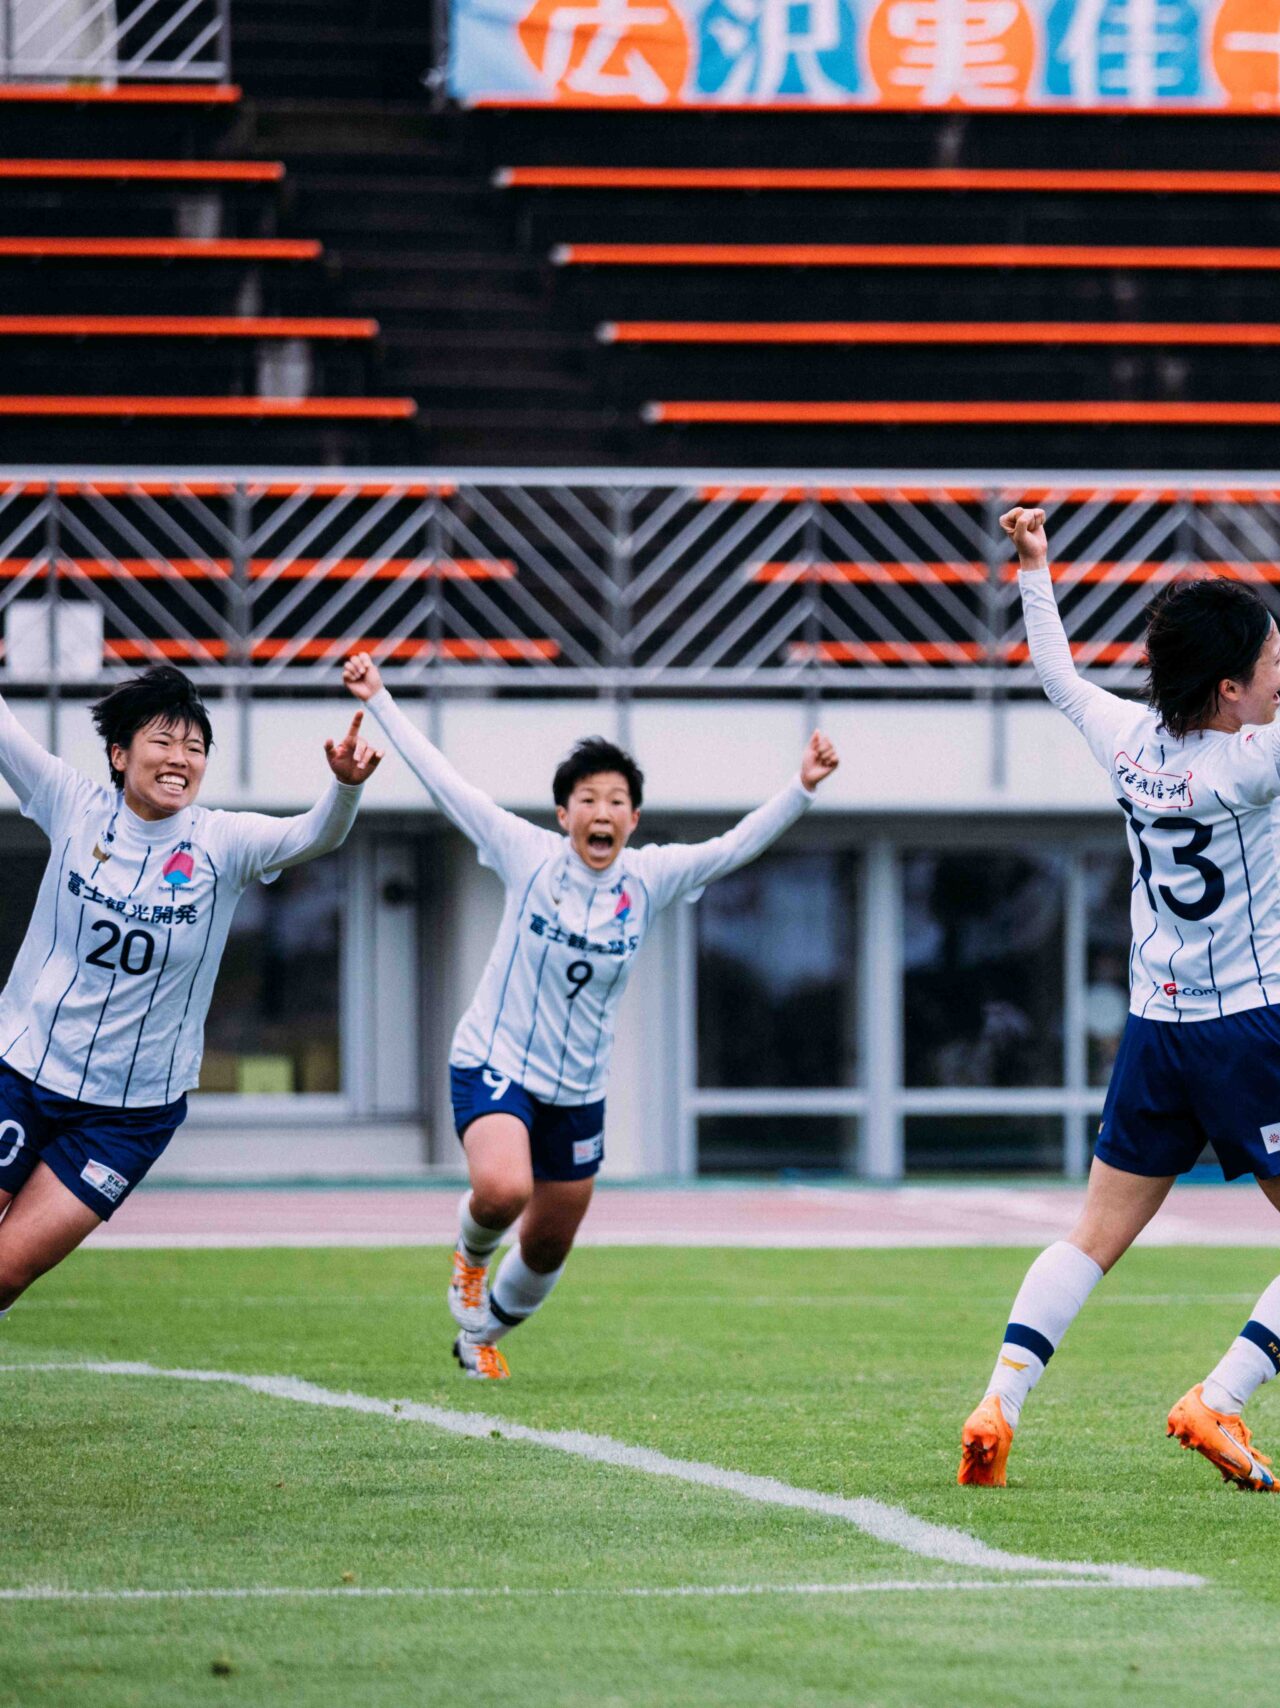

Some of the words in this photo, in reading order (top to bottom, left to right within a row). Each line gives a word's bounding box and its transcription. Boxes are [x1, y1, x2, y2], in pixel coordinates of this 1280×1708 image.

[1116, 797, 1226, 922] 13
[67, 869, 198, 925] 富士観光開発
[85, 919, 155, 976] 20
[566, 960, 595, 1000] 9
[482, 1069, 512, 1101] 9
